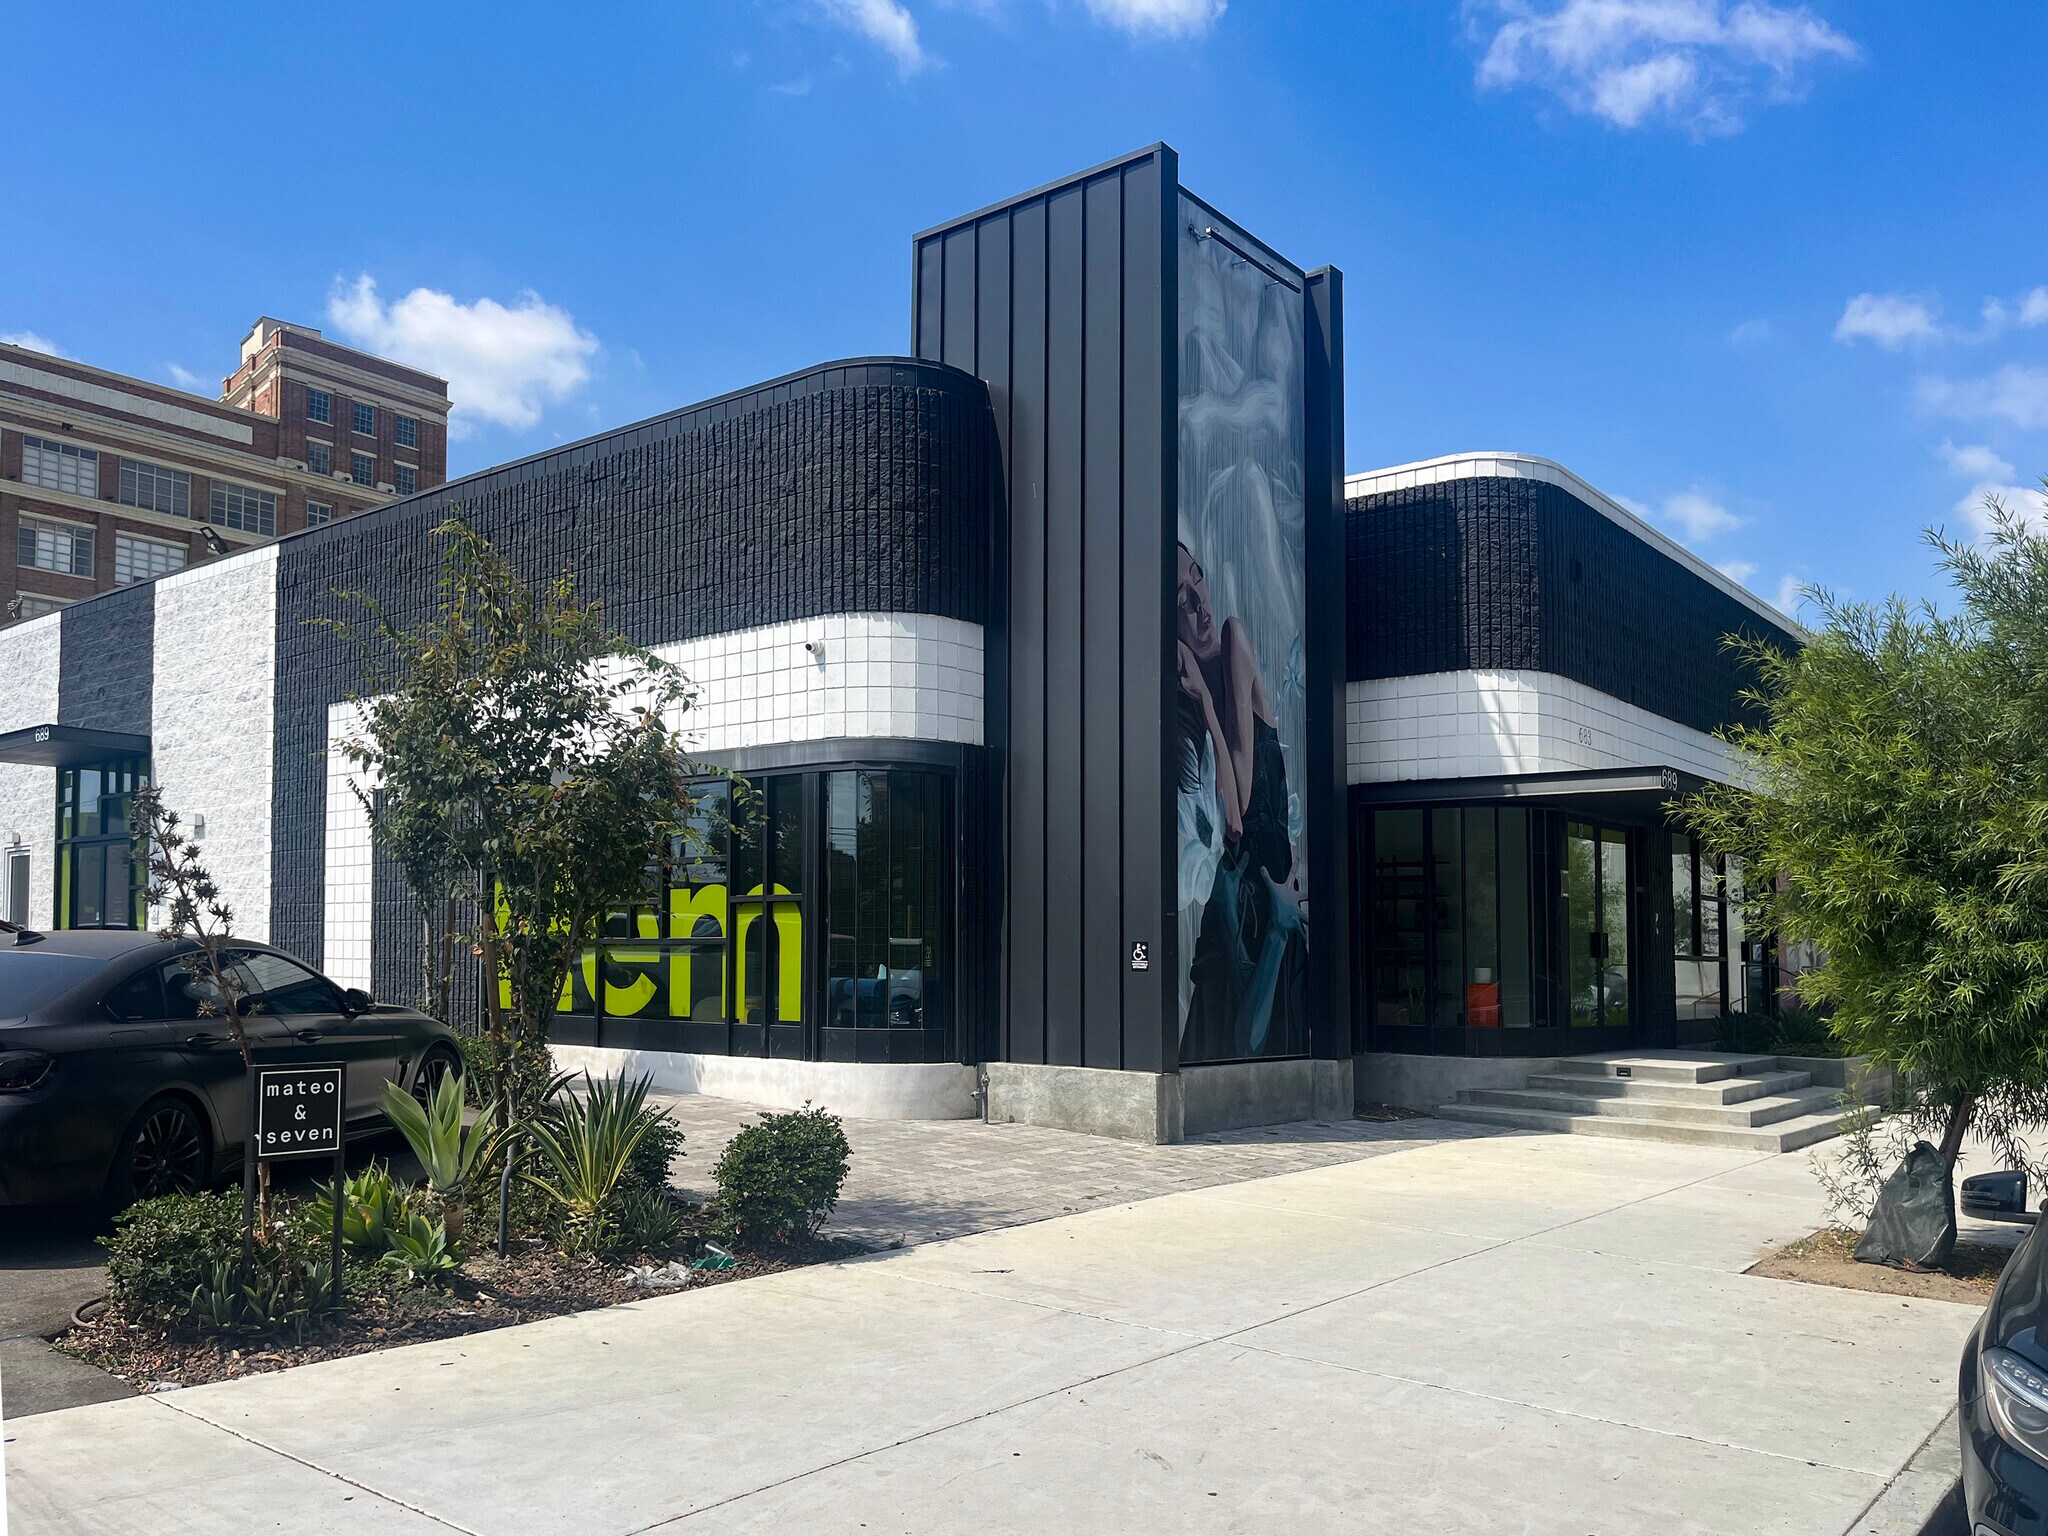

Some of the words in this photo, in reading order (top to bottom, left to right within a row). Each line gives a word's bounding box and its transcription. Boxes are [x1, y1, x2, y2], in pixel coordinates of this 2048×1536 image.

[14, 364, 116, 407] BISCUIT
[127, 397, 252, 443] COMPANY
[35, 726, 50, 742] 689
[1661, 769, 1677, 791] 689
[266, 1080, 335, 1097] mateo
[294, 1104, 307, 1120] &
[266, 1127, 333, 1144] seven
